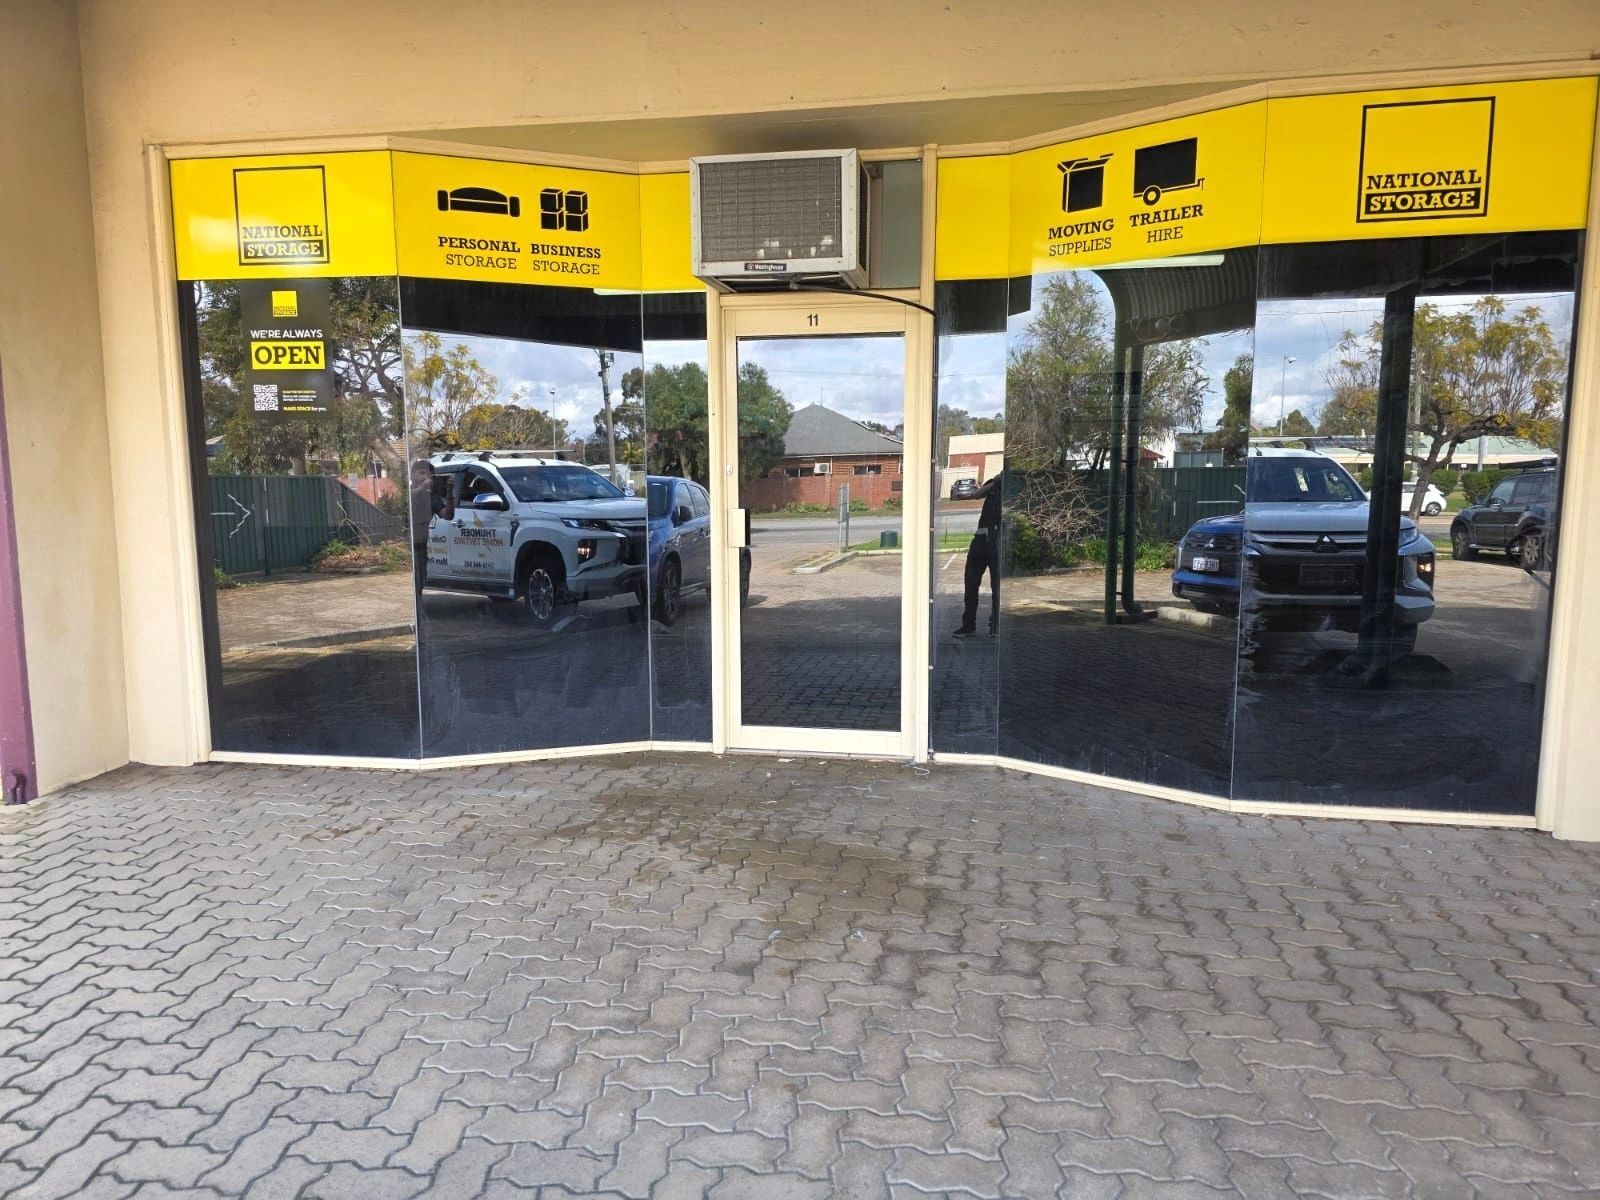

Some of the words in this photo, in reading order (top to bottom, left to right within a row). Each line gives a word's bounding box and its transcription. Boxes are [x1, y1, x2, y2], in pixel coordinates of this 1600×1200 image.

[1366, 169, 1481, 190] NATIONAL
[1370, 191, 1475, 212] STORAGE
[1130, 204, 1204, 227] TRAILER
[242, 224, 323, 239] NATIONAL
[1048, 218, 1114, 240] MOVING
[1146, 226, 1183, 243] HIRE
[247, 241, 321, 257] STORAGE
[438, 236, 520, 253] PERSONAL
[530, 243, 601, 259] BUSINESS
[1049, 237, 1112, 257] SUPPLIES
[446, 253, 517, 269] STORAGE
[532, 260, 600, 275] STORAGE
[807, 313, 818, 326] 11
[250, 329, 281, 339] WE'RE
[282, 329, 323, 338] ALWAYS
[254, 345, 321, 365] OPEN
